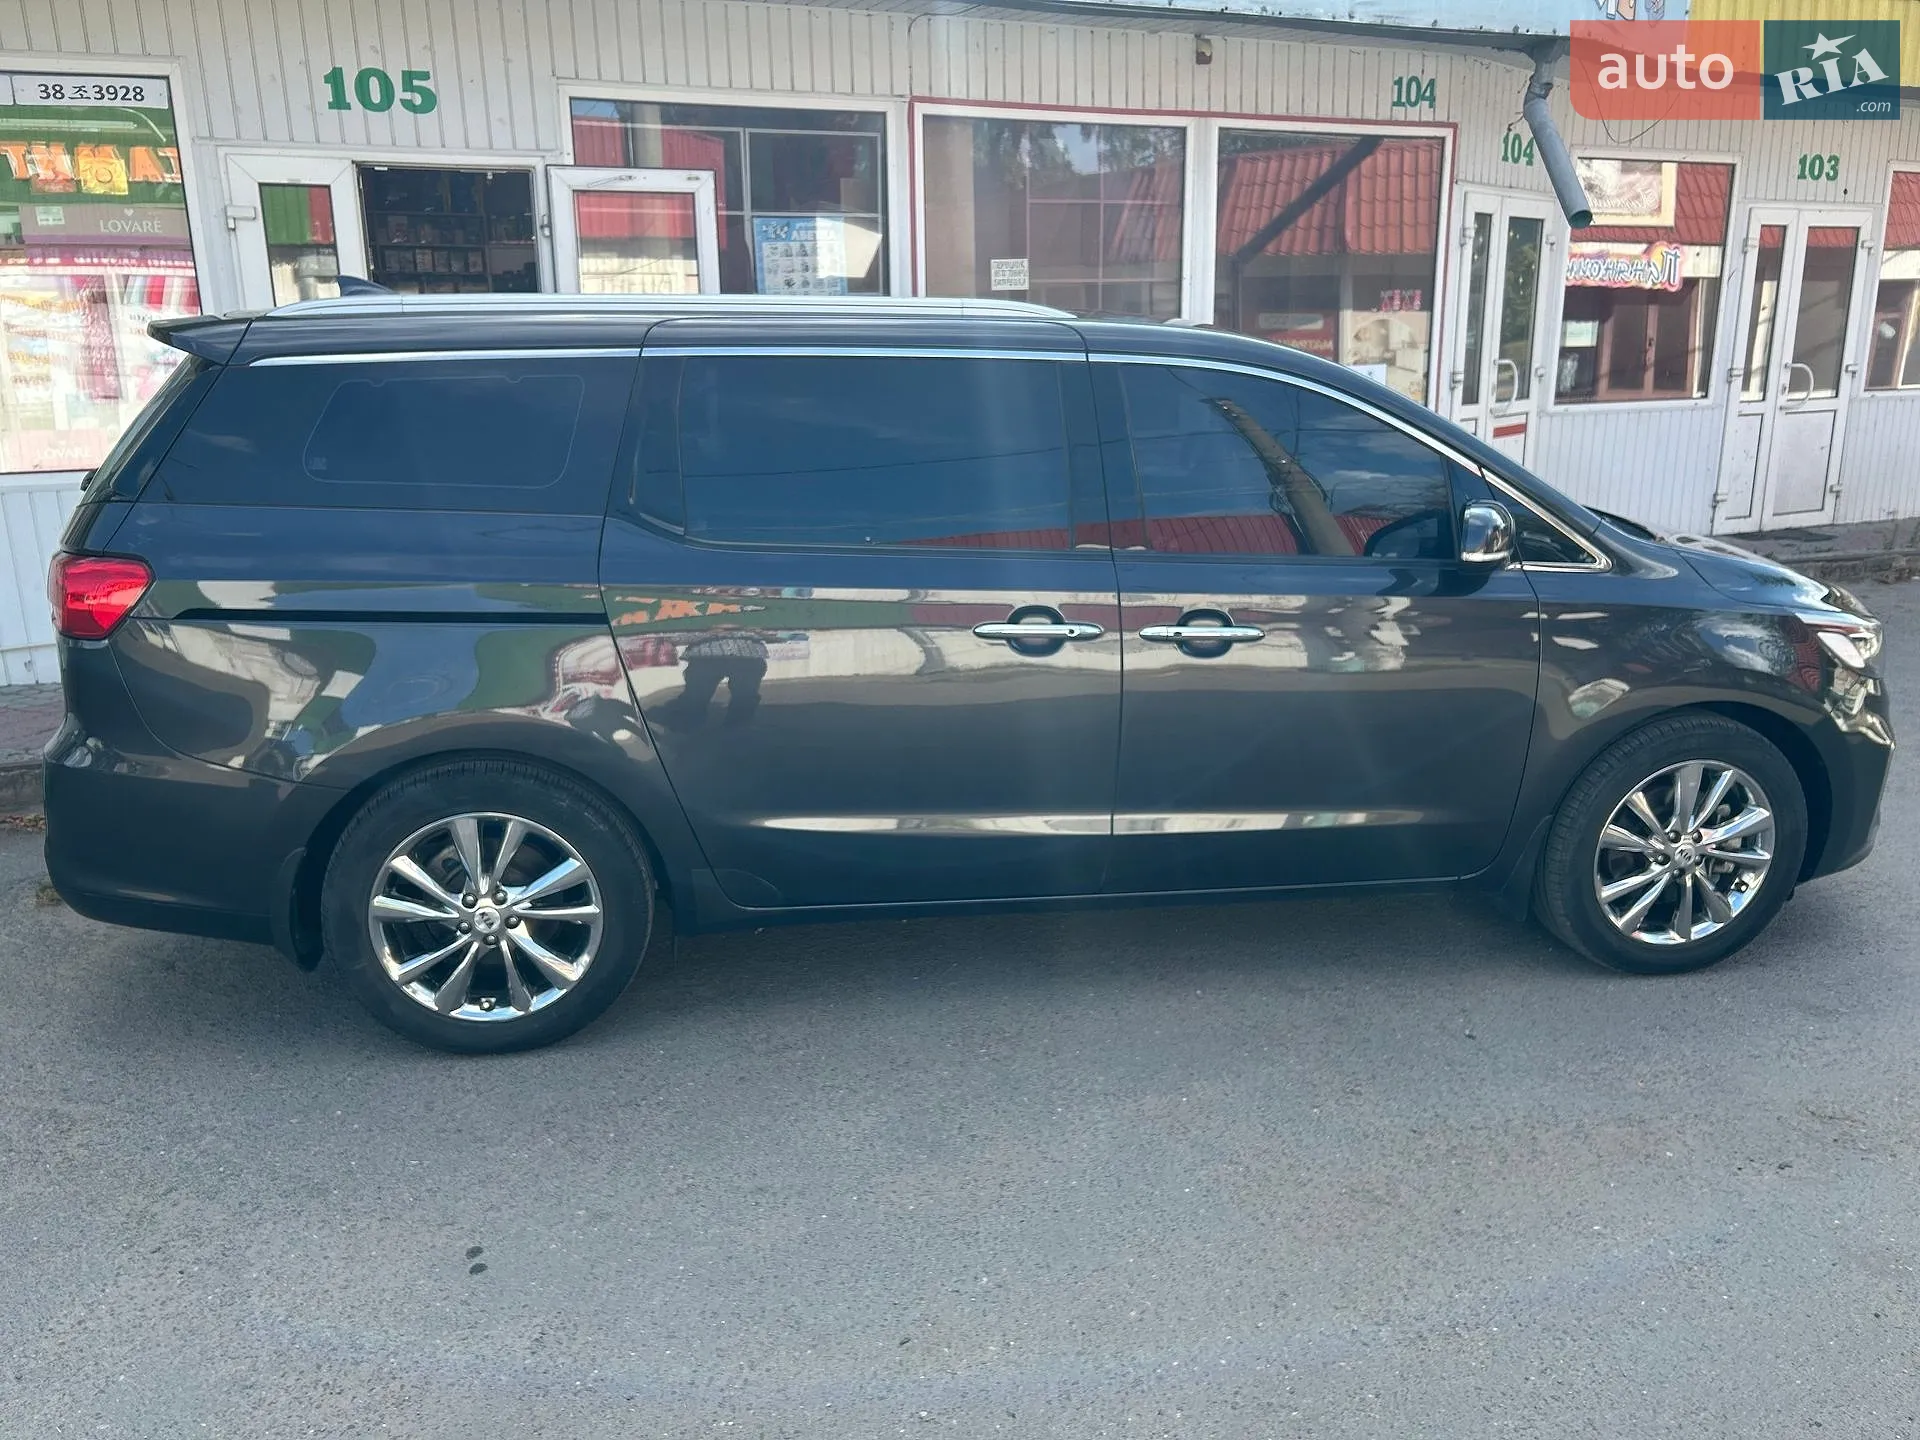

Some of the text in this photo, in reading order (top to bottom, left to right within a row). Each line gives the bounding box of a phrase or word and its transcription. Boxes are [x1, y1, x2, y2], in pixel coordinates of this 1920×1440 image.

[323, 65, 438, 114] 105
[1392, 75, 1436, 109] 104
[1501, 132, 1535, 166] 104
[1796, 153, 1841, 182] 103
